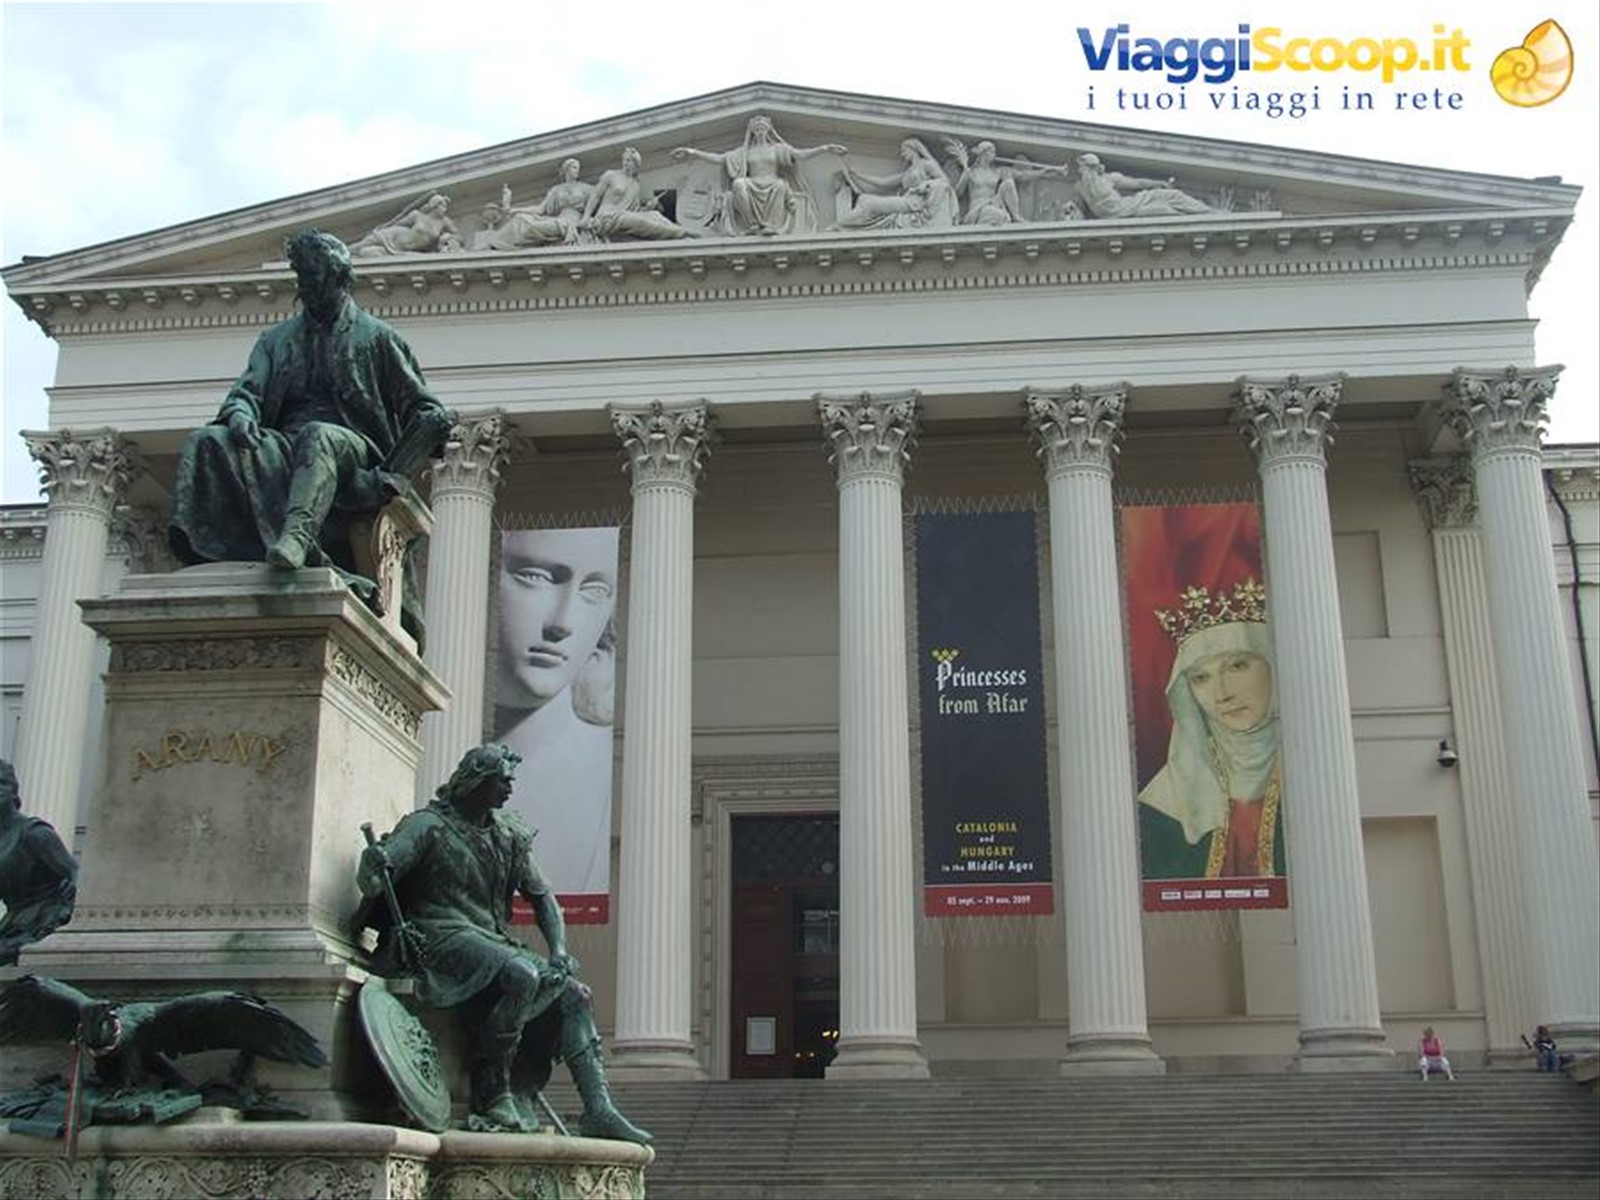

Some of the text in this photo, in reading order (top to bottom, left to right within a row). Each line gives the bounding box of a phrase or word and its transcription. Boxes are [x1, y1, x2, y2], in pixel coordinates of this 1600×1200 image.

[936, 660, 1027, 691] Princesses
[939, 692, 1028, 714] from Afar
[131, 730, 288, 783] ARANY
[955, 822, 1017, 833] CATALONIA
[979, 835, 995, 843] and
[961, 845, 1014, 857] HUNGARY
[952, 863, 965, 871] the
[967, 861, 1005, 871] Middle
[1008, 860, 1034, 873] Ages
